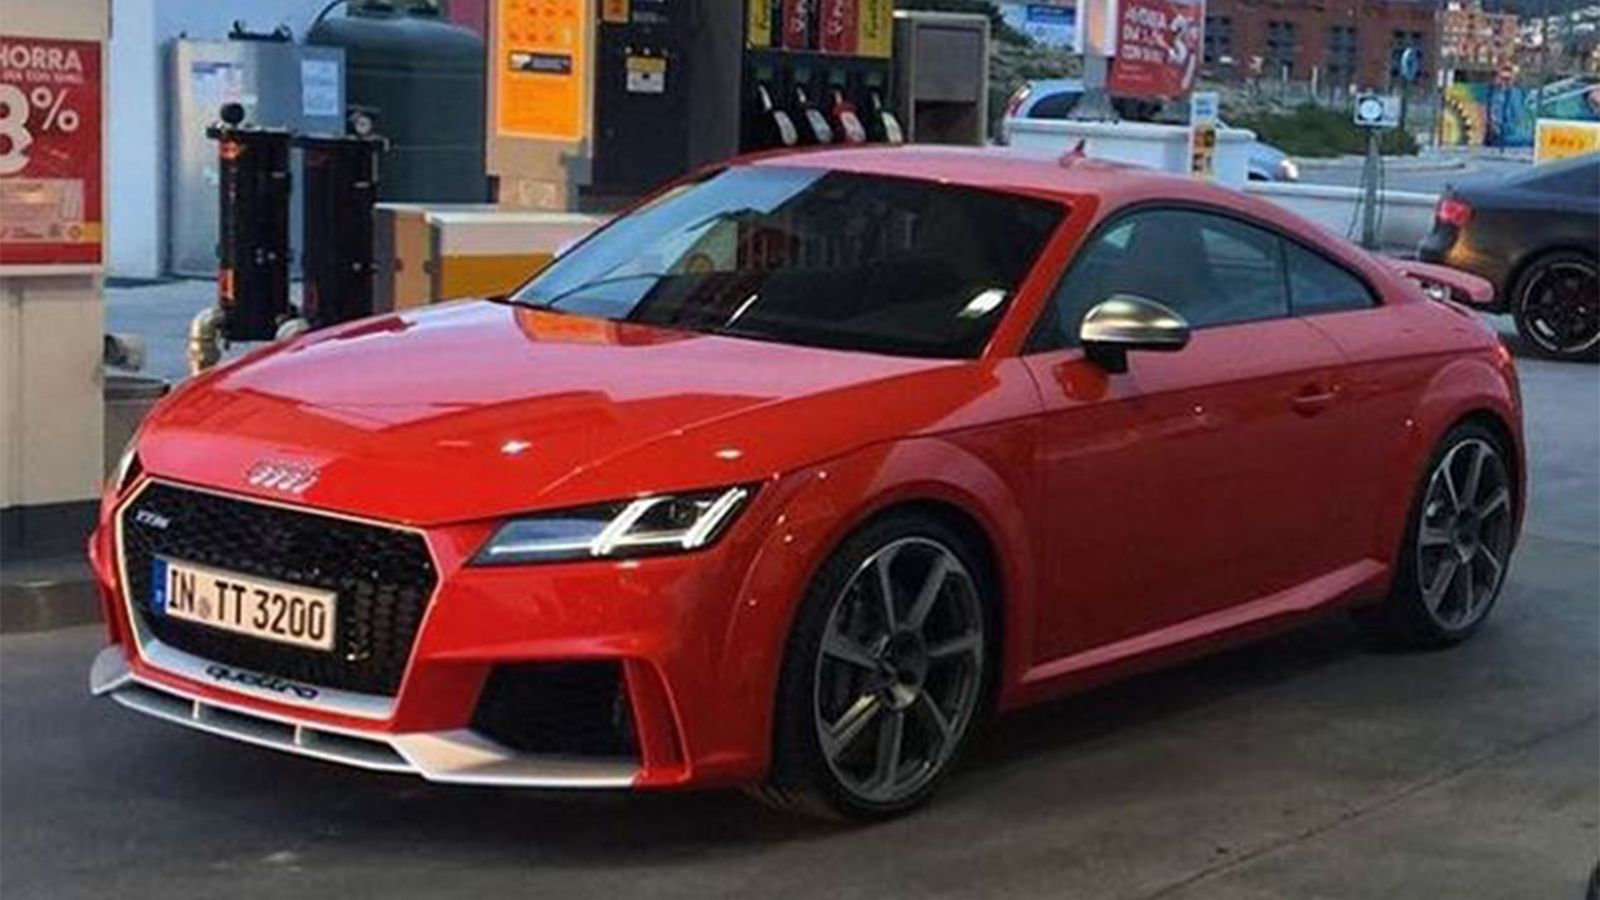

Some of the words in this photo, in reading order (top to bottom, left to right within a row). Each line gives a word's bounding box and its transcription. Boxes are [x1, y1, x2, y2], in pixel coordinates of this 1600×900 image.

[170, 569, 196, 611] IN
[214, 580, 247, 625] TT
[253, 589, 326, 641] 3200
[204, 664, 320, 701] quattro
